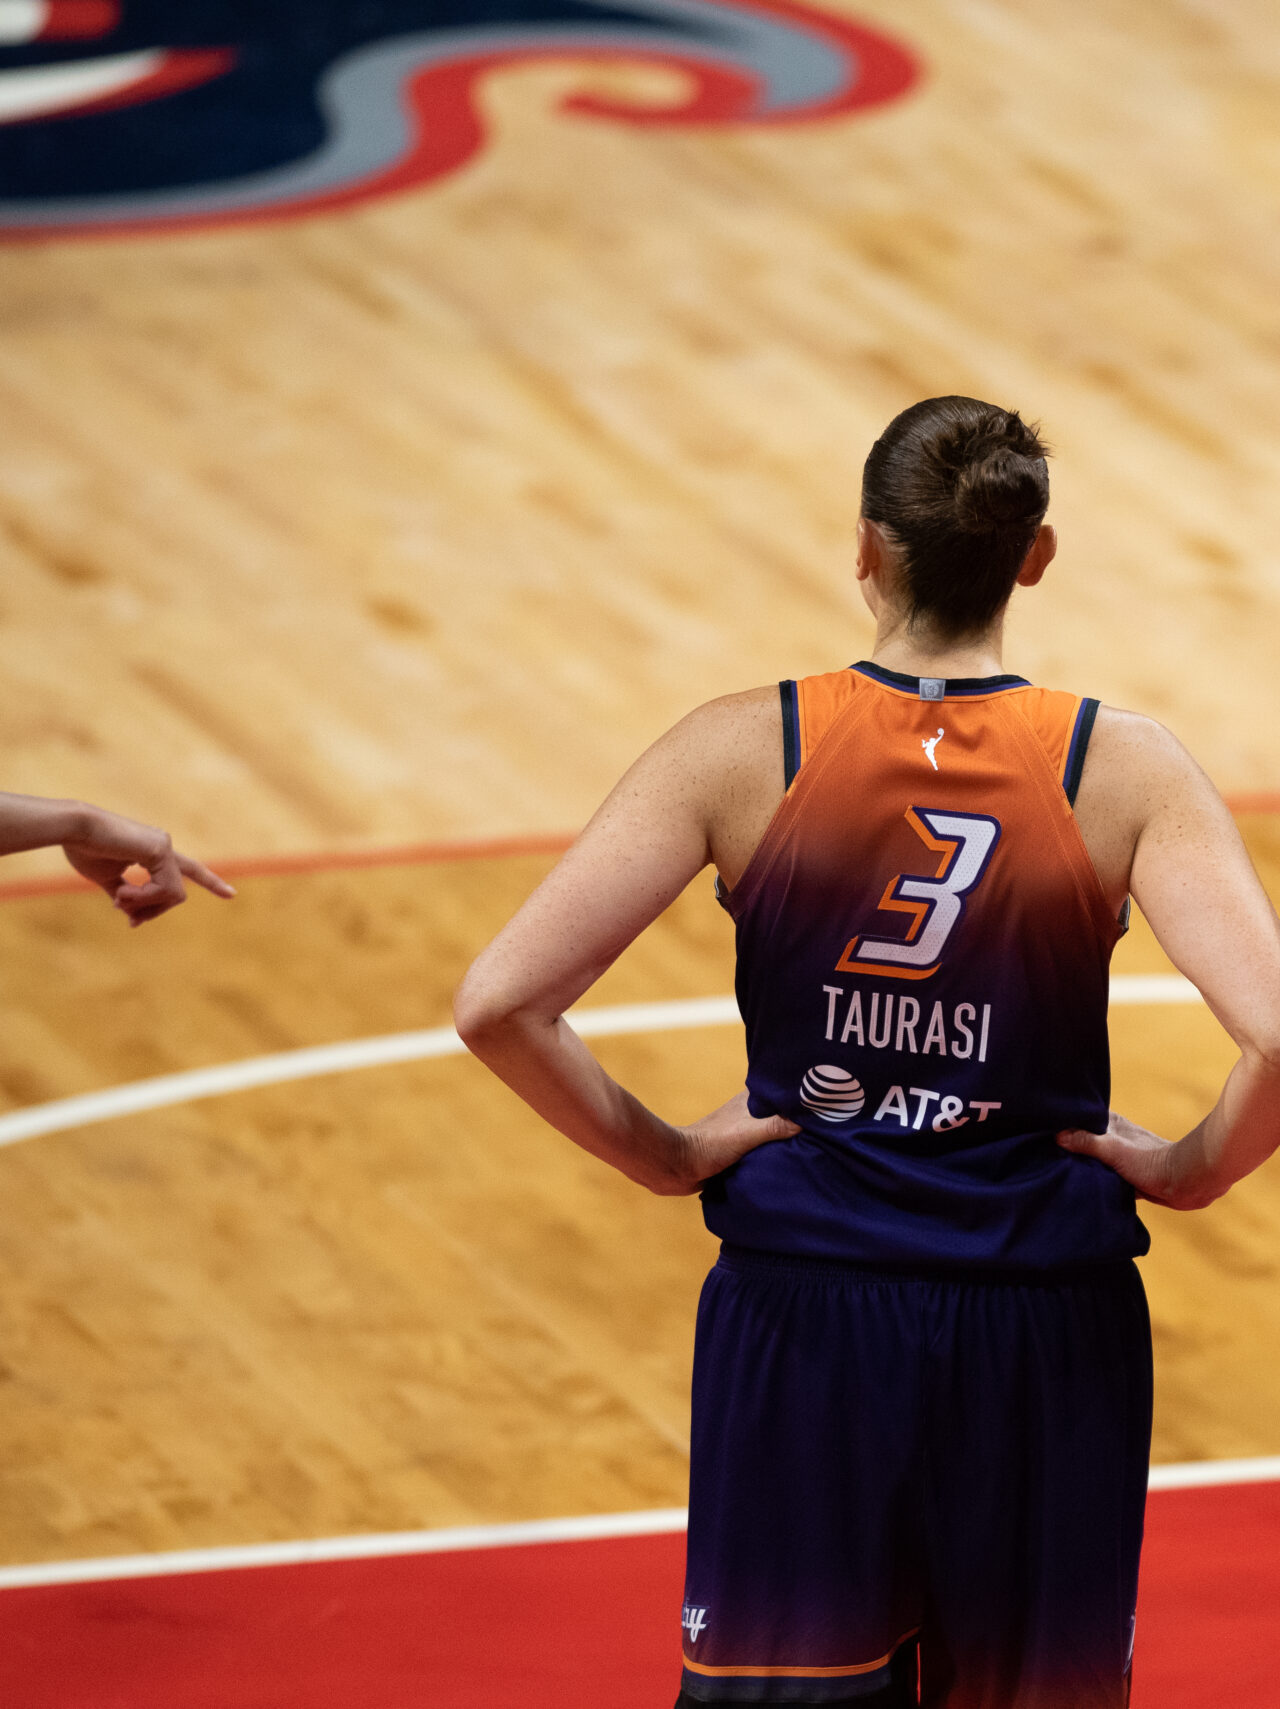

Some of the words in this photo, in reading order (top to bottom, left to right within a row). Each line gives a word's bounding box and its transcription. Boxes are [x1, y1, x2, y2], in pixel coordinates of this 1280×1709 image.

[835, 805, 1002, 979] 3
[823, 985, 992, 1063] TAURASI
[873, 1085, 1002, 1133] AT&T
